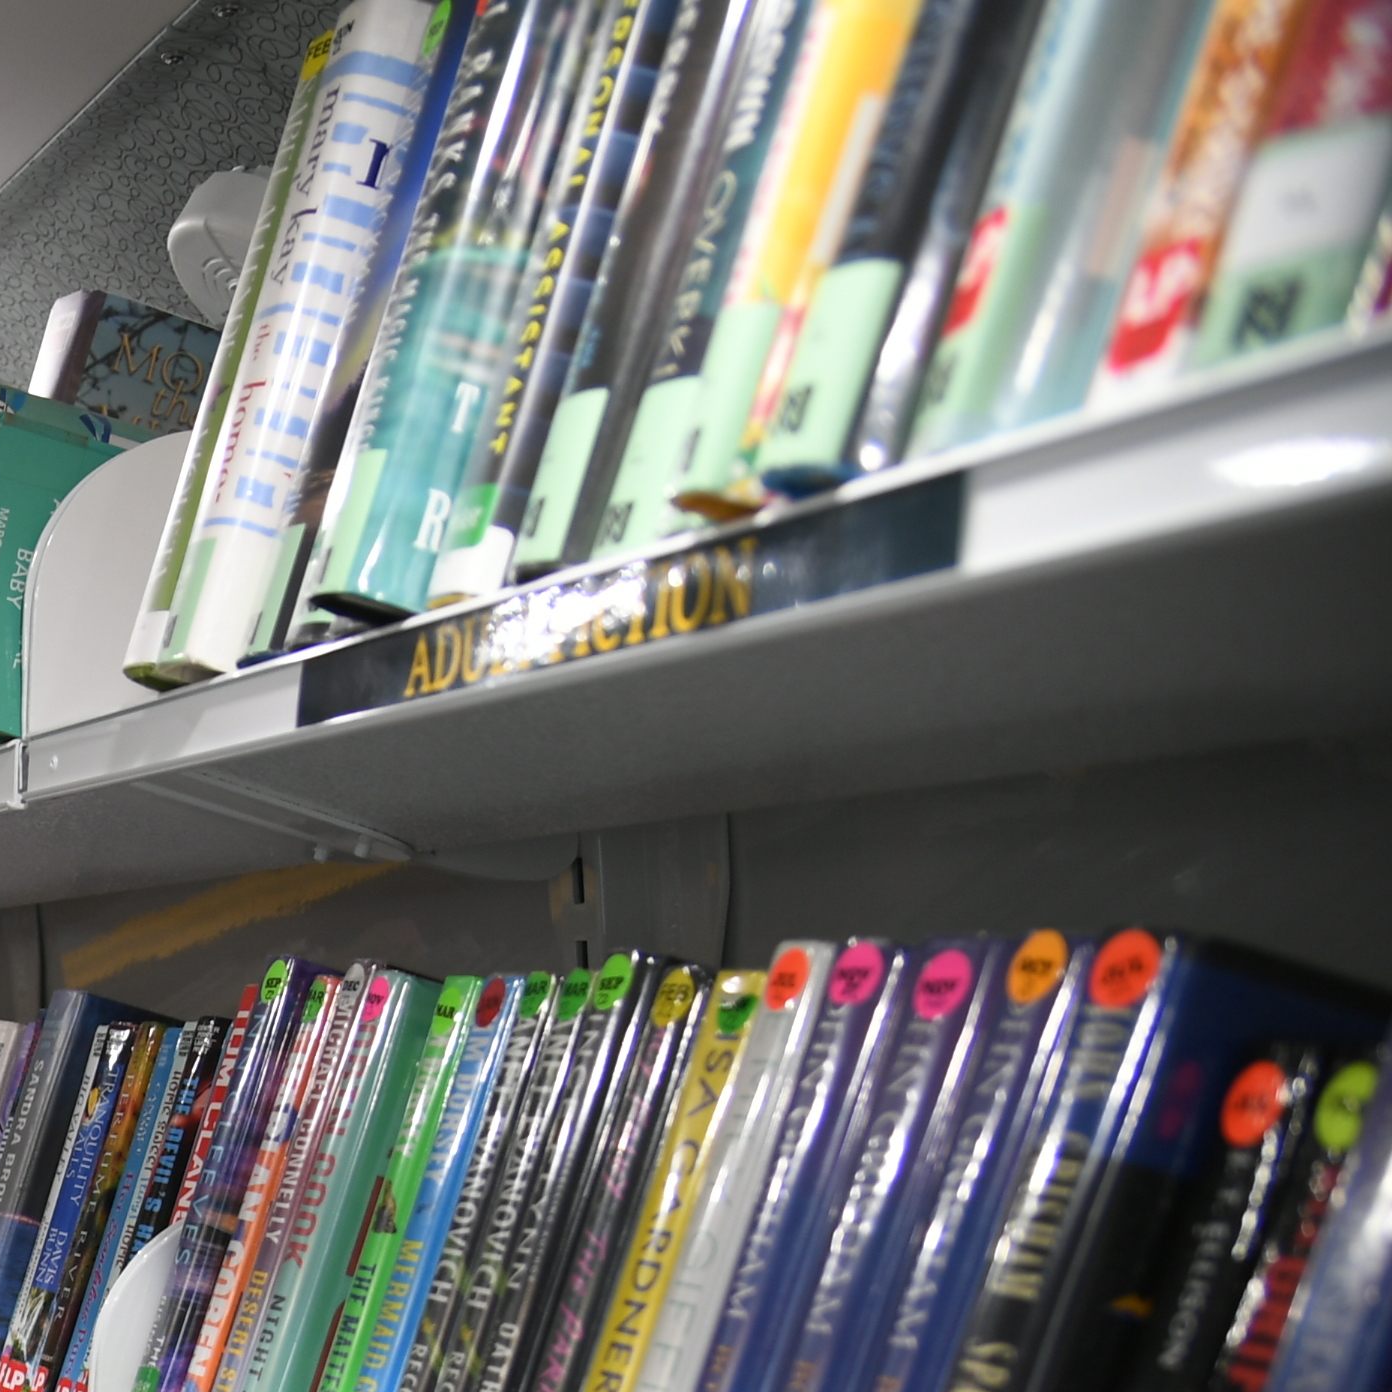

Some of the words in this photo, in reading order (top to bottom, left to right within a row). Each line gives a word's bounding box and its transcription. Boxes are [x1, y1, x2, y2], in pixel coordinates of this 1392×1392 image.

[266, 978, 281, 989] SEP
[342, 980, 359, 991] DEC
[437, 1004, 455, 1018] MAR
[215, 1010, 251, 1082] TOM
[11, 1059, 45, 1147] SANDRA
[70, 1067, 121, 1207] TRANQUILITY
[179, 1078, 199, 1116] THE
[87, 1074, 135, 1213] PERFUME
[145, 1128, 184, 1212] DEVIL'S
[266, 1119, 311, 1244] CONNELLY
[283, 1155, 336, 1268] COOK
[36, 1227, 56, 1283] BUNN
[45, 1230, 68, 1285] DAVIS
[57, 1230, 88, 1319] RIVER
[349, 1262, 376, 1307] THE
[192, 1240, 246, 1378] COBEN
[232, 1270, 268, 1357] DESERT
[248, 1294, 286, 1381] NIGHT
[365, 1239, 423, 1371] MERMAID
[4, 1365, 25, 1390] LP
[32, 1371, 45, 1391] LP
